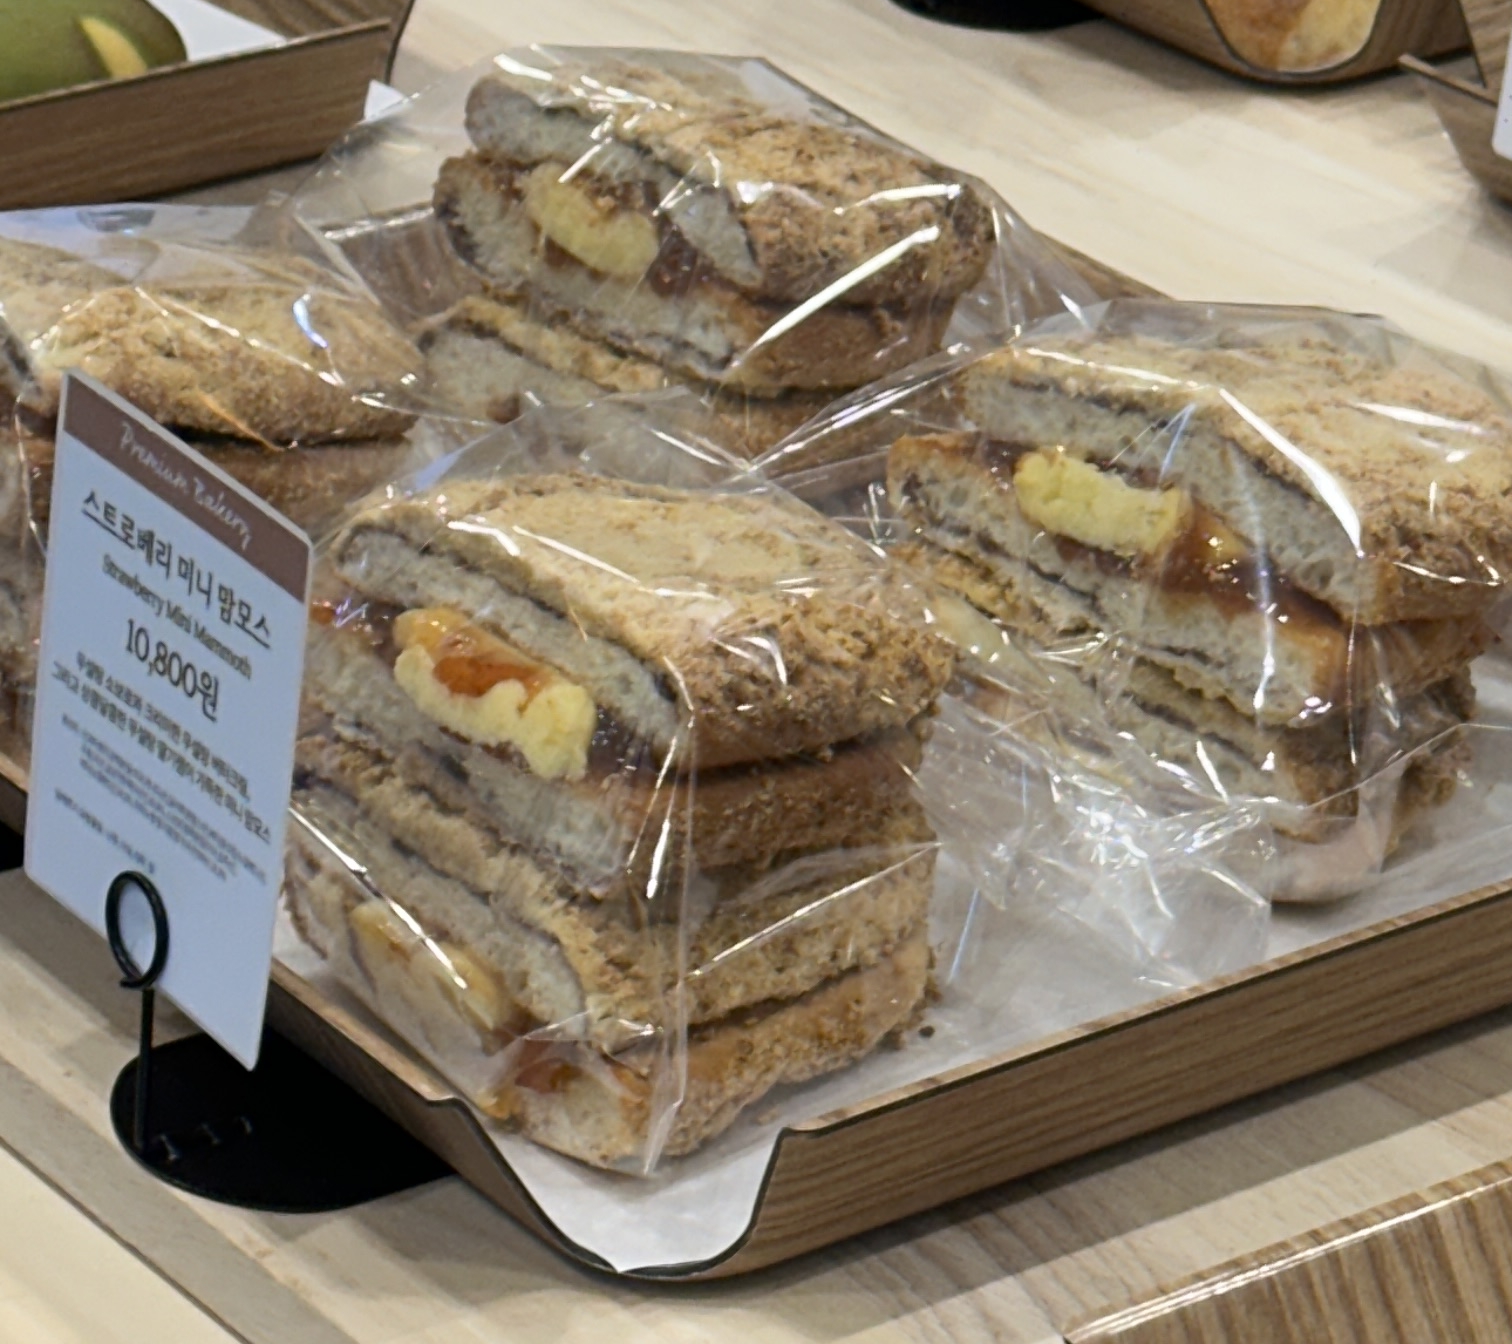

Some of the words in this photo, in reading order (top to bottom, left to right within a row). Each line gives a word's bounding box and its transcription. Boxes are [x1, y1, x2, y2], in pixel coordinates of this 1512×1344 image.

[120, 421, 188, 494] Premium
[193, 476, 251, 551] Bakery
[81, 490, 173, 580] 스트로베리
[177, 555, 214, 610] 미니
[217, 583, 271, 650] 맘모스
[102, 553, 166, 618] Strawberry
[165, 599, 192, 635] Mini
[192, 619, 252, 681] Mammoth
[125, 618, 220, 723] 10,800원
[51, 660, 80, 695] 그리고
[223, 792, 244, 822] 미니
[243, 808, 271, 845] 맘모스
